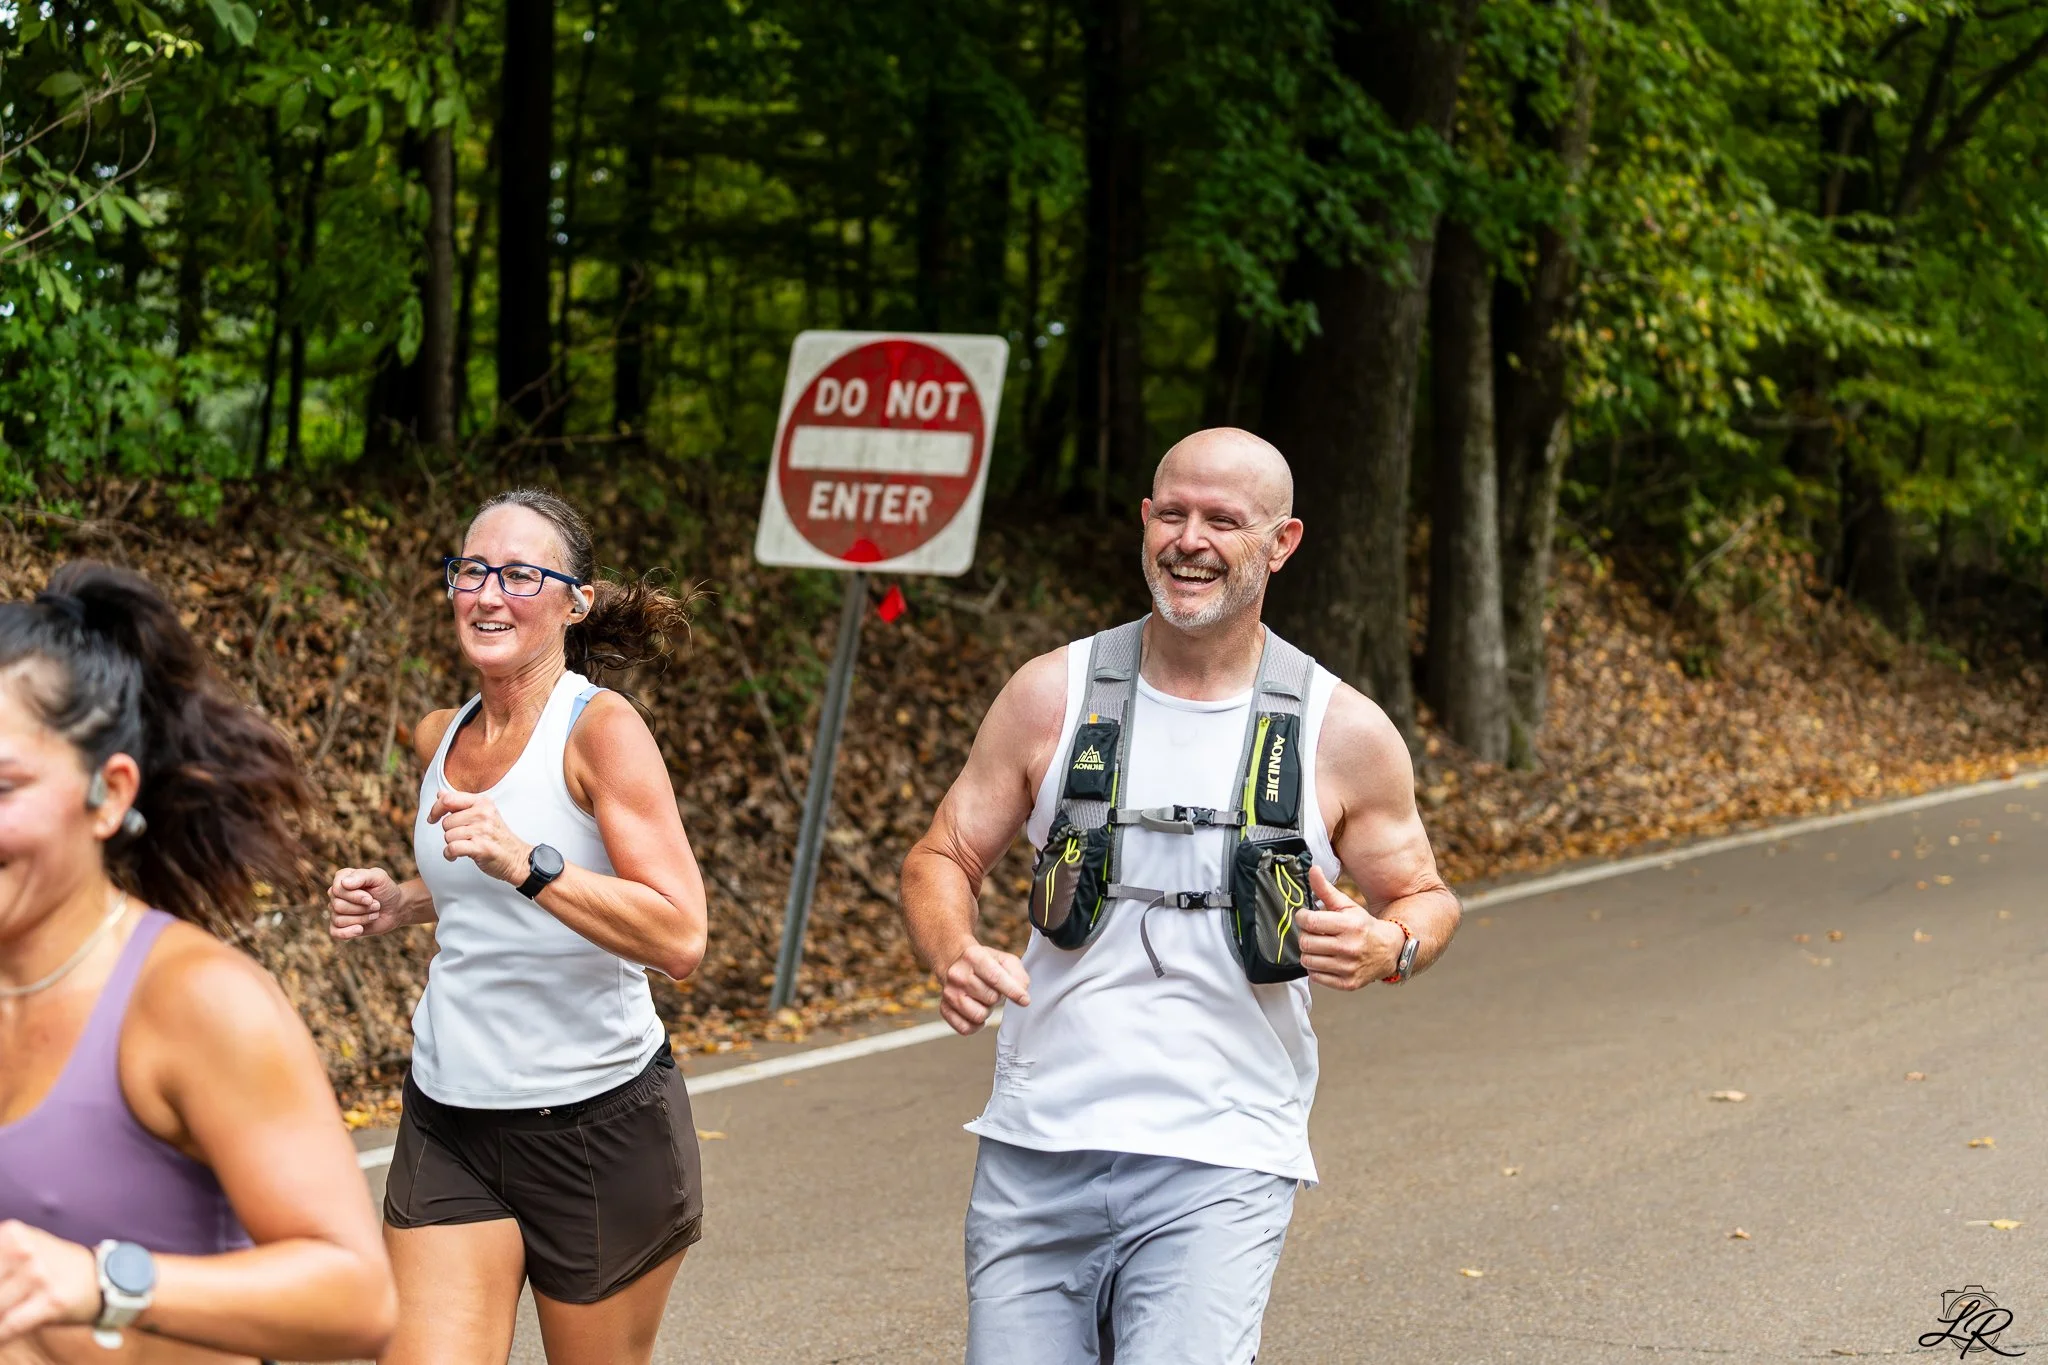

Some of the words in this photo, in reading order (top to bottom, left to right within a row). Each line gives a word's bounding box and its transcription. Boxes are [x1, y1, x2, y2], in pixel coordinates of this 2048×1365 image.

[814, 377, 868, 417] DO
[885, 379, 968, 421] NOT
[807, 481, 933, 524] ENTER
[1266, 733, 1286, 803] AONIJIE
